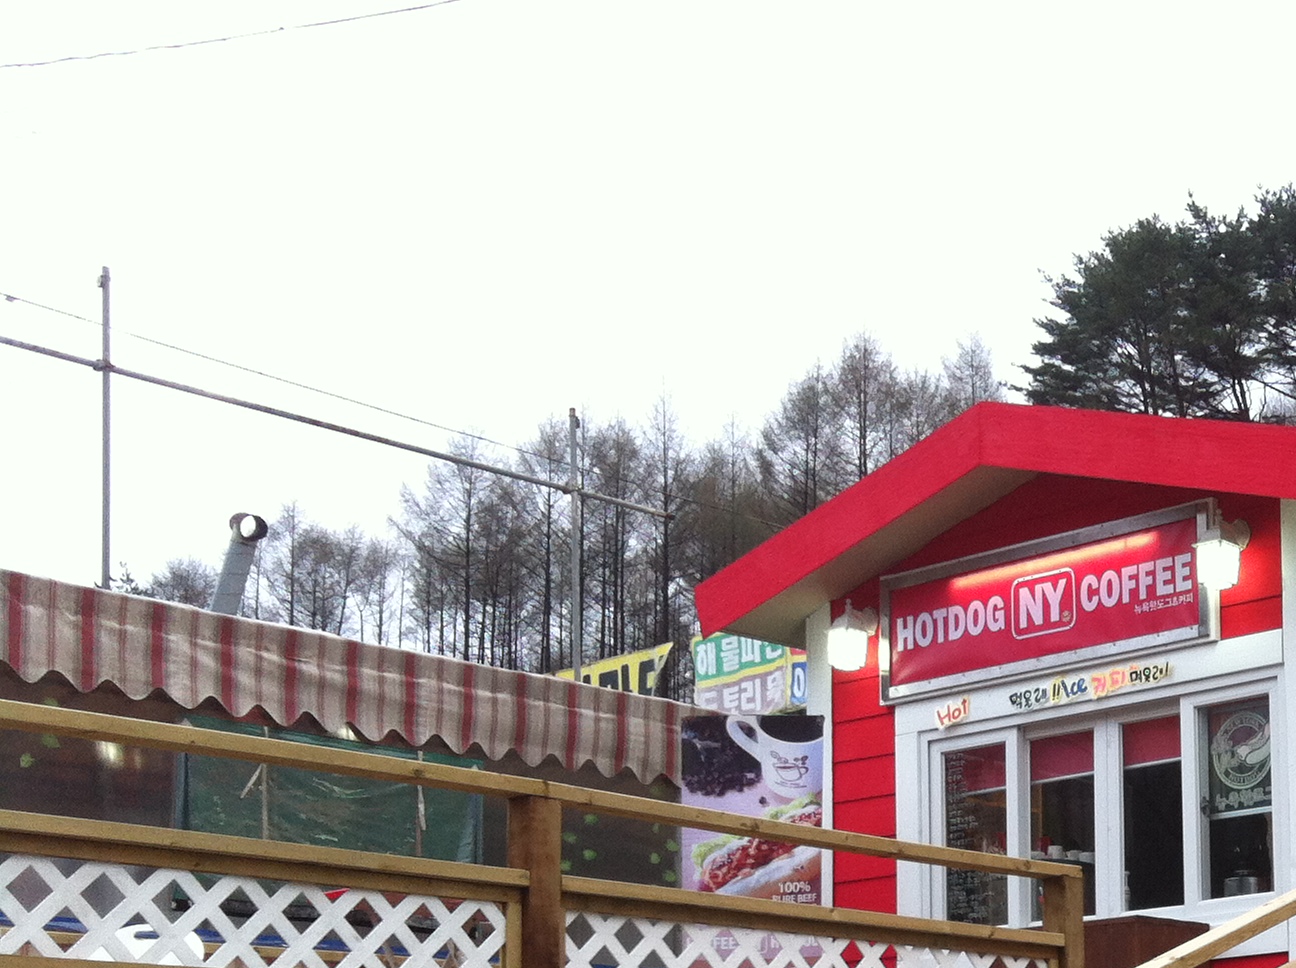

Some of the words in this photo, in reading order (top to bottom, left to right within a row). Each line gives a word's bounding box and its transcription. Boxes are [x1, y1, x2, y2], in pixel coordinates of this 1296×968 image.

[896, 596, 1005, 652] HOTDOG
[1018, 578, 1067, 629] NY
[1080, 552, 1192, 612] COFFEE
[936, 699, 968, 726] Hot
[778, 881, 811, 893] 100%
